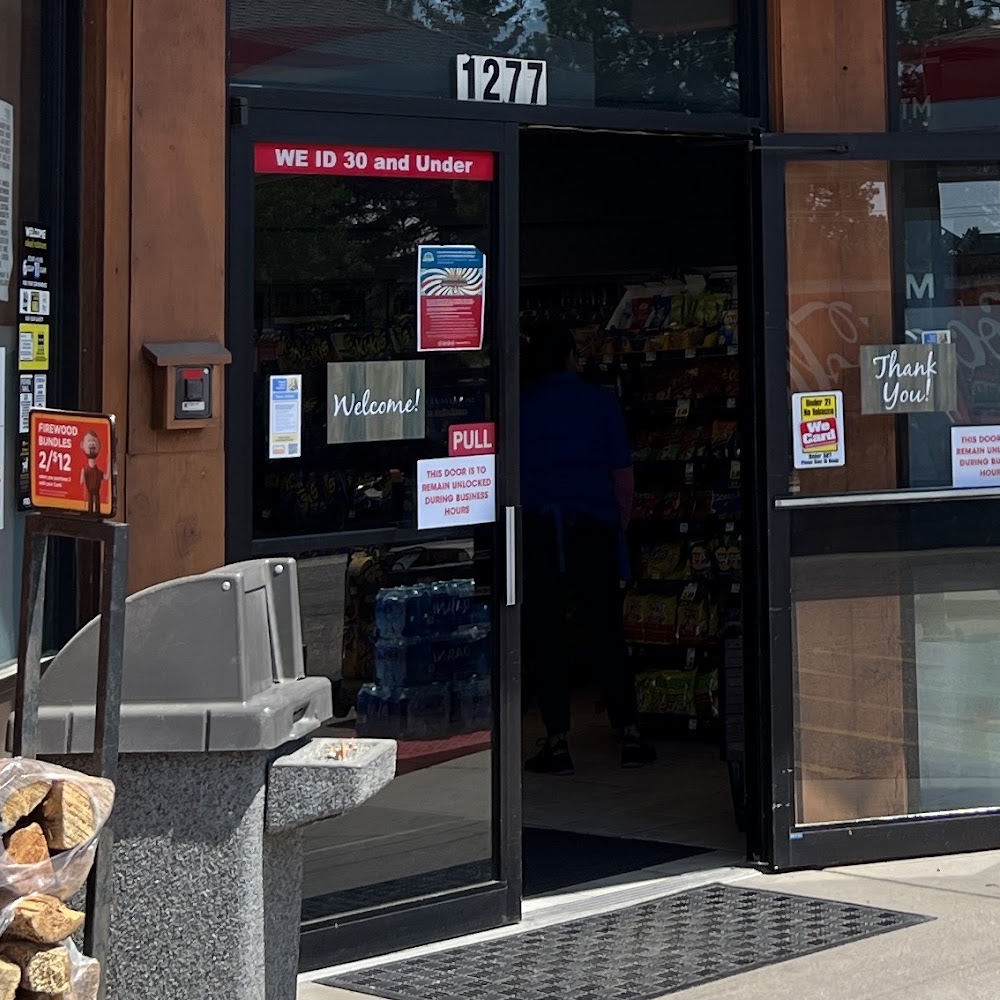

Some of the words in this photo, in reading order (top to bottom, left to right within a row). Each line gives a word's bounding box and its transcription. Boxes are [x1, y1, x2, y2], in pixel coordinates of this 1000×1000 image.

[462, 58, 543, 105] 1277
[275, 149, 308, 168] WE
[315, 150, 337, 168] ID
[343, 151, 368, 170] 30
[373, 153, 410, 172] and
[416, 155, 473, 174] Under
[873, 349, 937, 380] Thank
[883, 378, 931, 411] You!
[333, 388, 420, 417] Welcome!
[38, 422, 79, 437] FIREWOOD
[806, 421, 830, 433] We
[38, 435, 73, 448] BUNDLES
[452, 429, 493, 451] PULL
[802, 429, 836, 444] Card
[961, 435, 977, 443] THIS
[979, 434, 1000, 443] DOOR
[956, 447, 985, 455] REMAIN
[39, 449, 72, 472] 2/$12
[960, 458, 989, 467] DURING
[427, 470, 442, 478] THIS
[444, 468, 467, 478] DOOR
[468, 467, 475, 475] IS
[477, 465, 486, 474] TO
[421, 481, 450, 492] REMAIN
[452, 478, 492, 490] UNLOCKED
[424, 494, 454, 505] DURING
[455, 491, 489, 502] BUSINESS
[444, 505, 470, 515] HOURS
